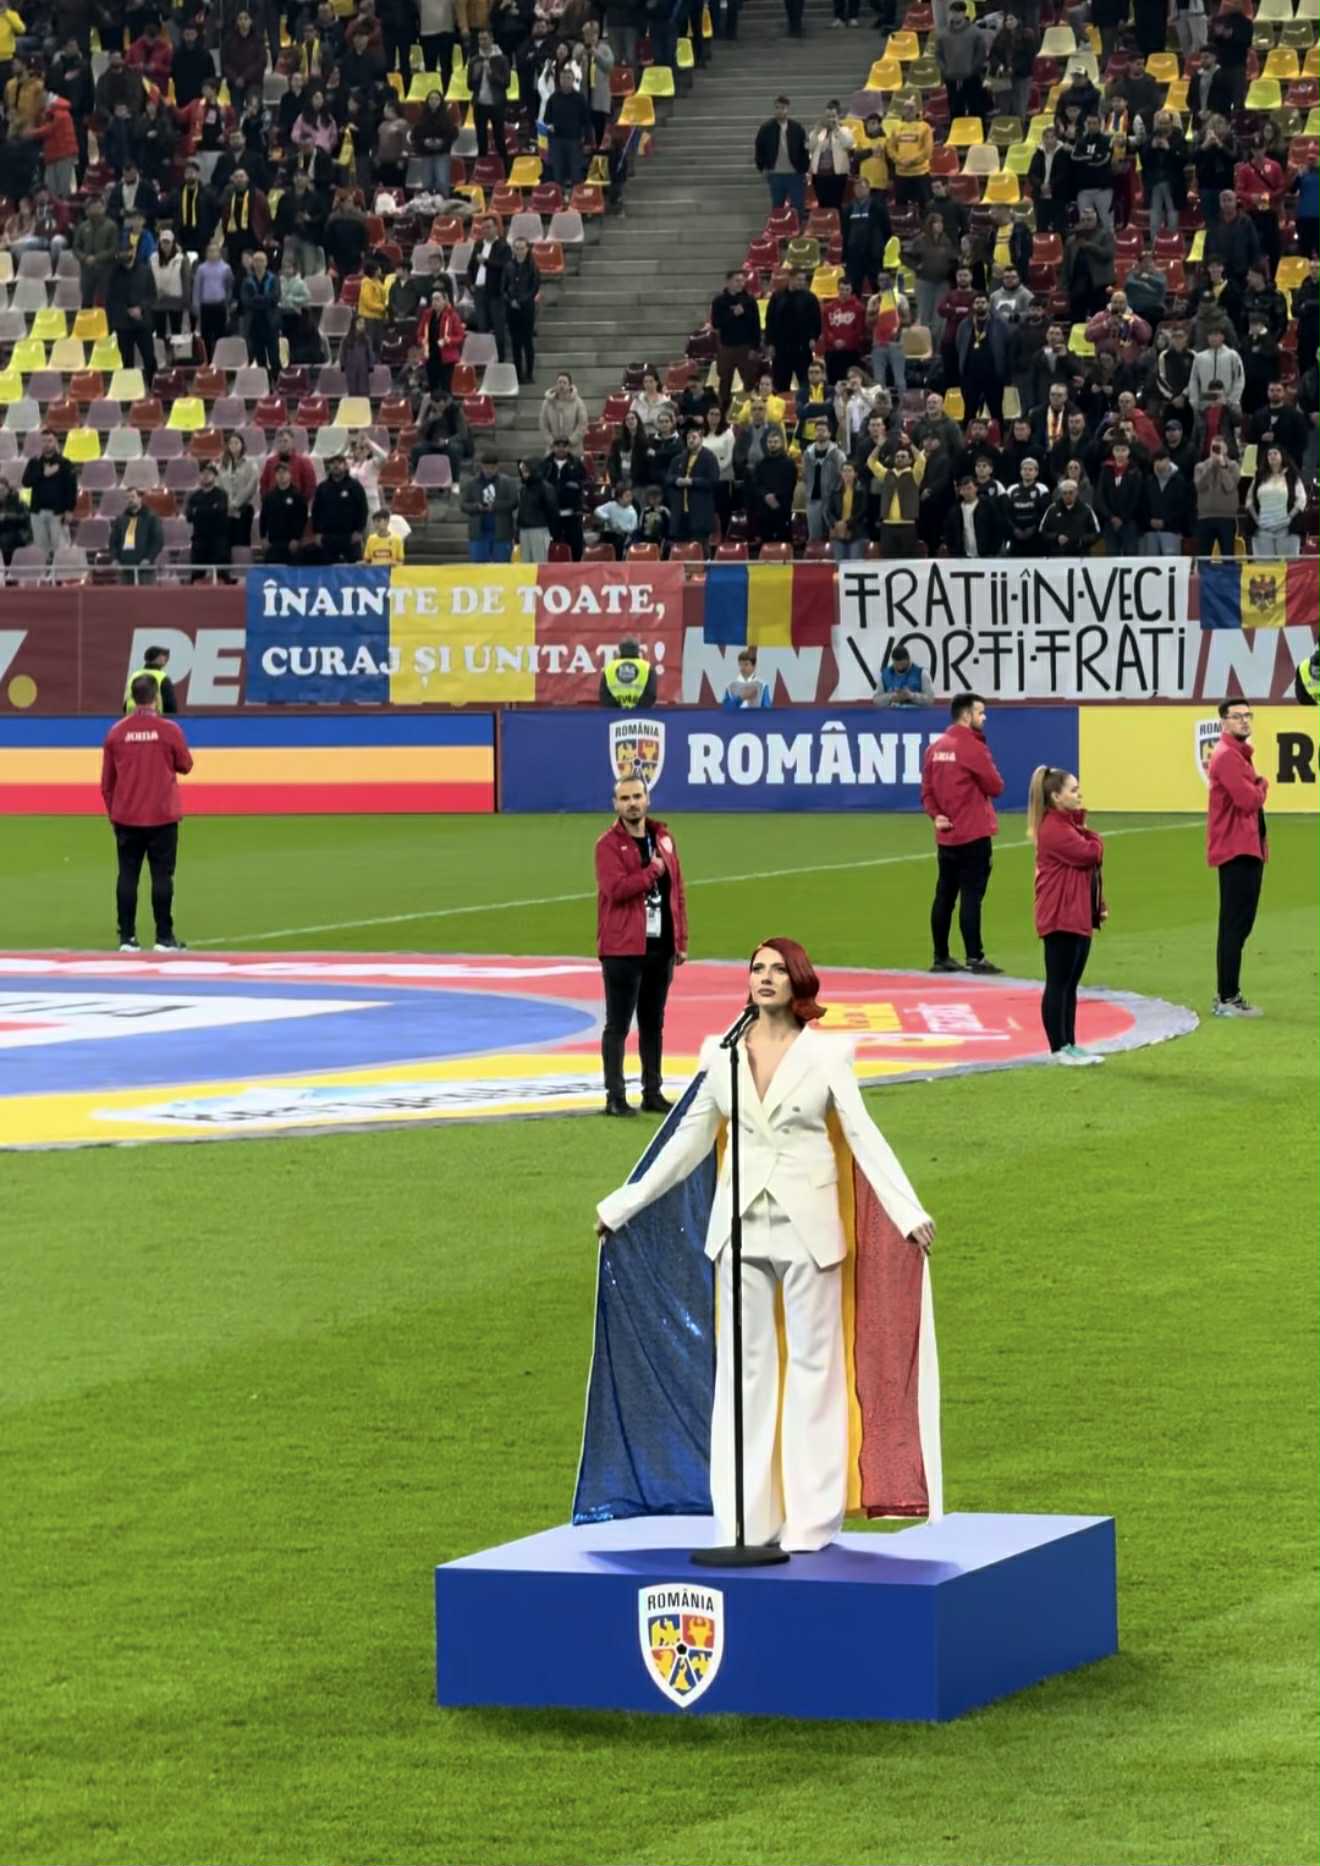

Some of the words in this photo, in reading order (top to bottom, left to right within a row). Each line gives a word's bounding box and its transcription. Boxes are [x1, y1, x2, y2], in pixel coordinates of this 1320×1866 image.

[263, 578, 439, 617] ÎNAINTE
[450, 585, 505, 615] DE
[516, 584, 666, 621] TOATE,
[261, 645, 401, 676] CURAJ
[413, 645, 451, 689] ȘI
[463, 641, 666, 676] UNITAT!
[614, 721, 660, 738] ROMÂNIA
[687, 720, 946, 785] ROMÂNI
[1276, 731, 1320, 784] R
[647, 1587, 715, 1612] ROMÂNIA
